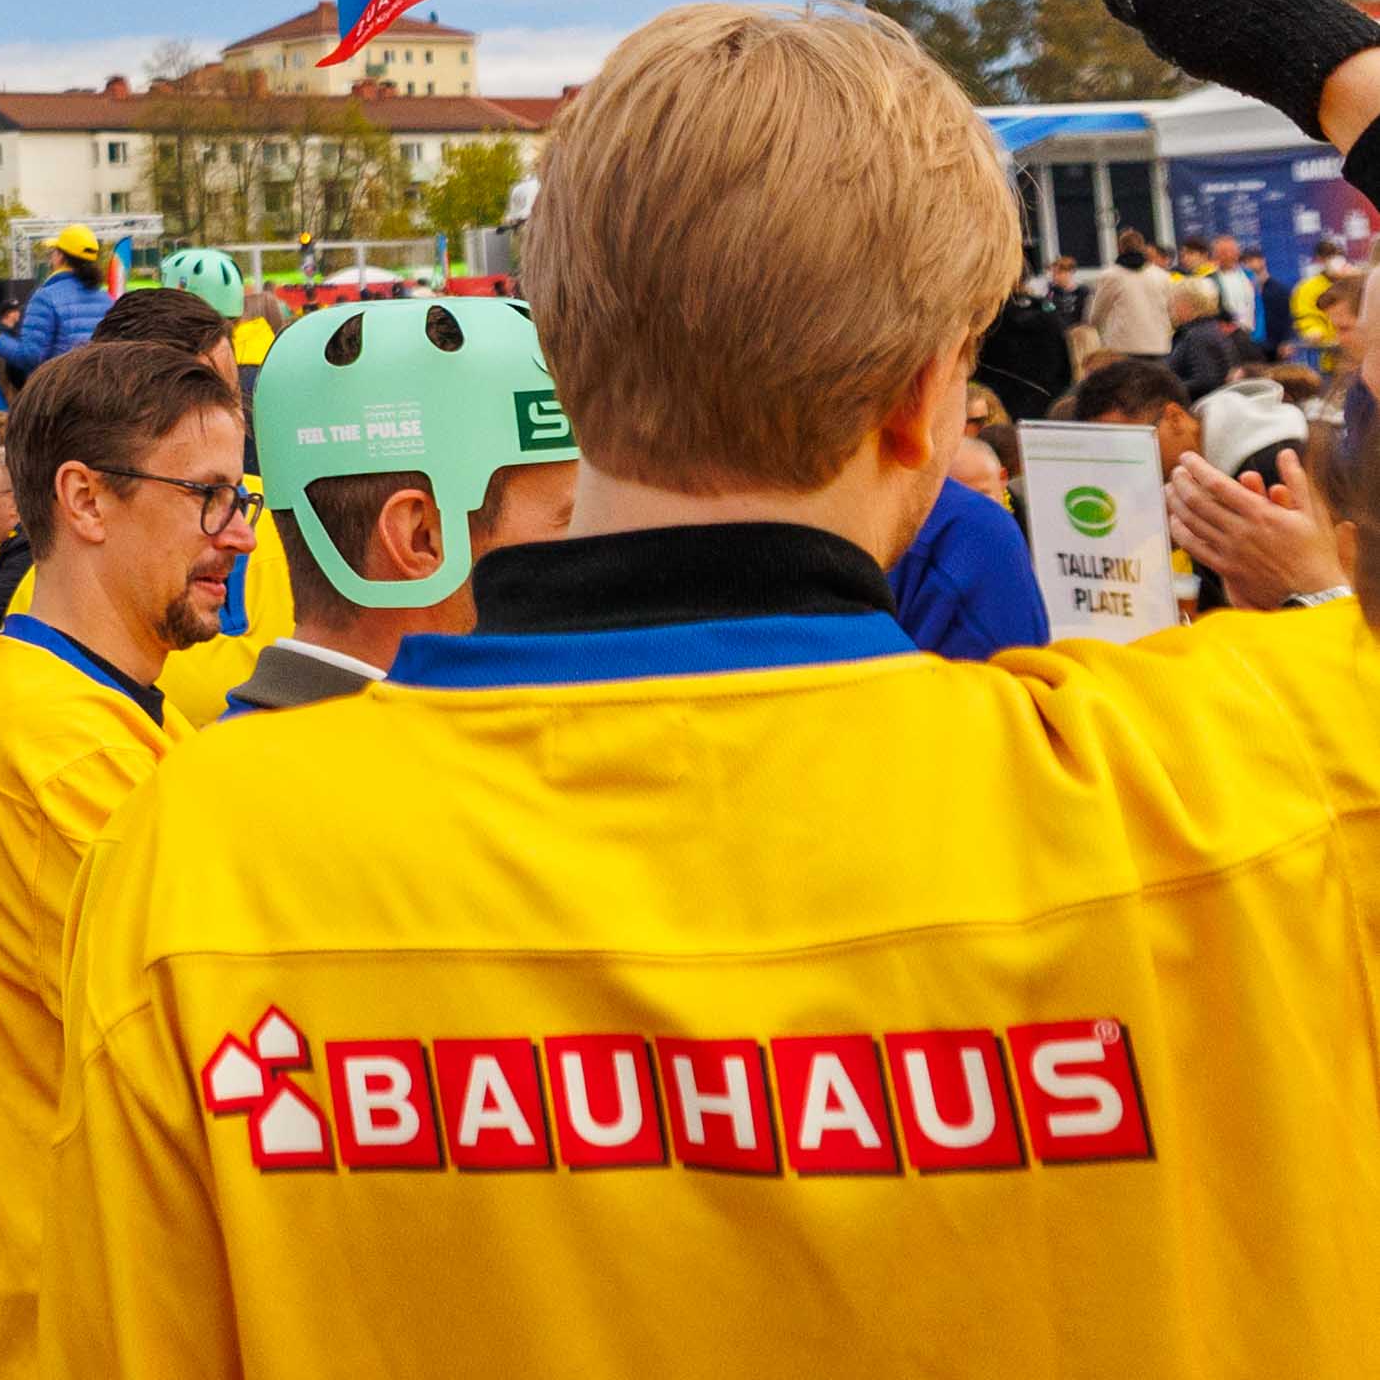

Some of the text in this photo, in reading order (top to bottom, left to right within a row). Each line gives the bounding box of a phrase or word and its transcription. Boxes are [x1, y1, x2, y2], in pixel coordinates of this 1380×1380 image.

[366, 420, 422, 440] PULSE
[1074, 587, 1133, 617] PLATE
[344, 1037, 1125, 1151] BAUHAUS
